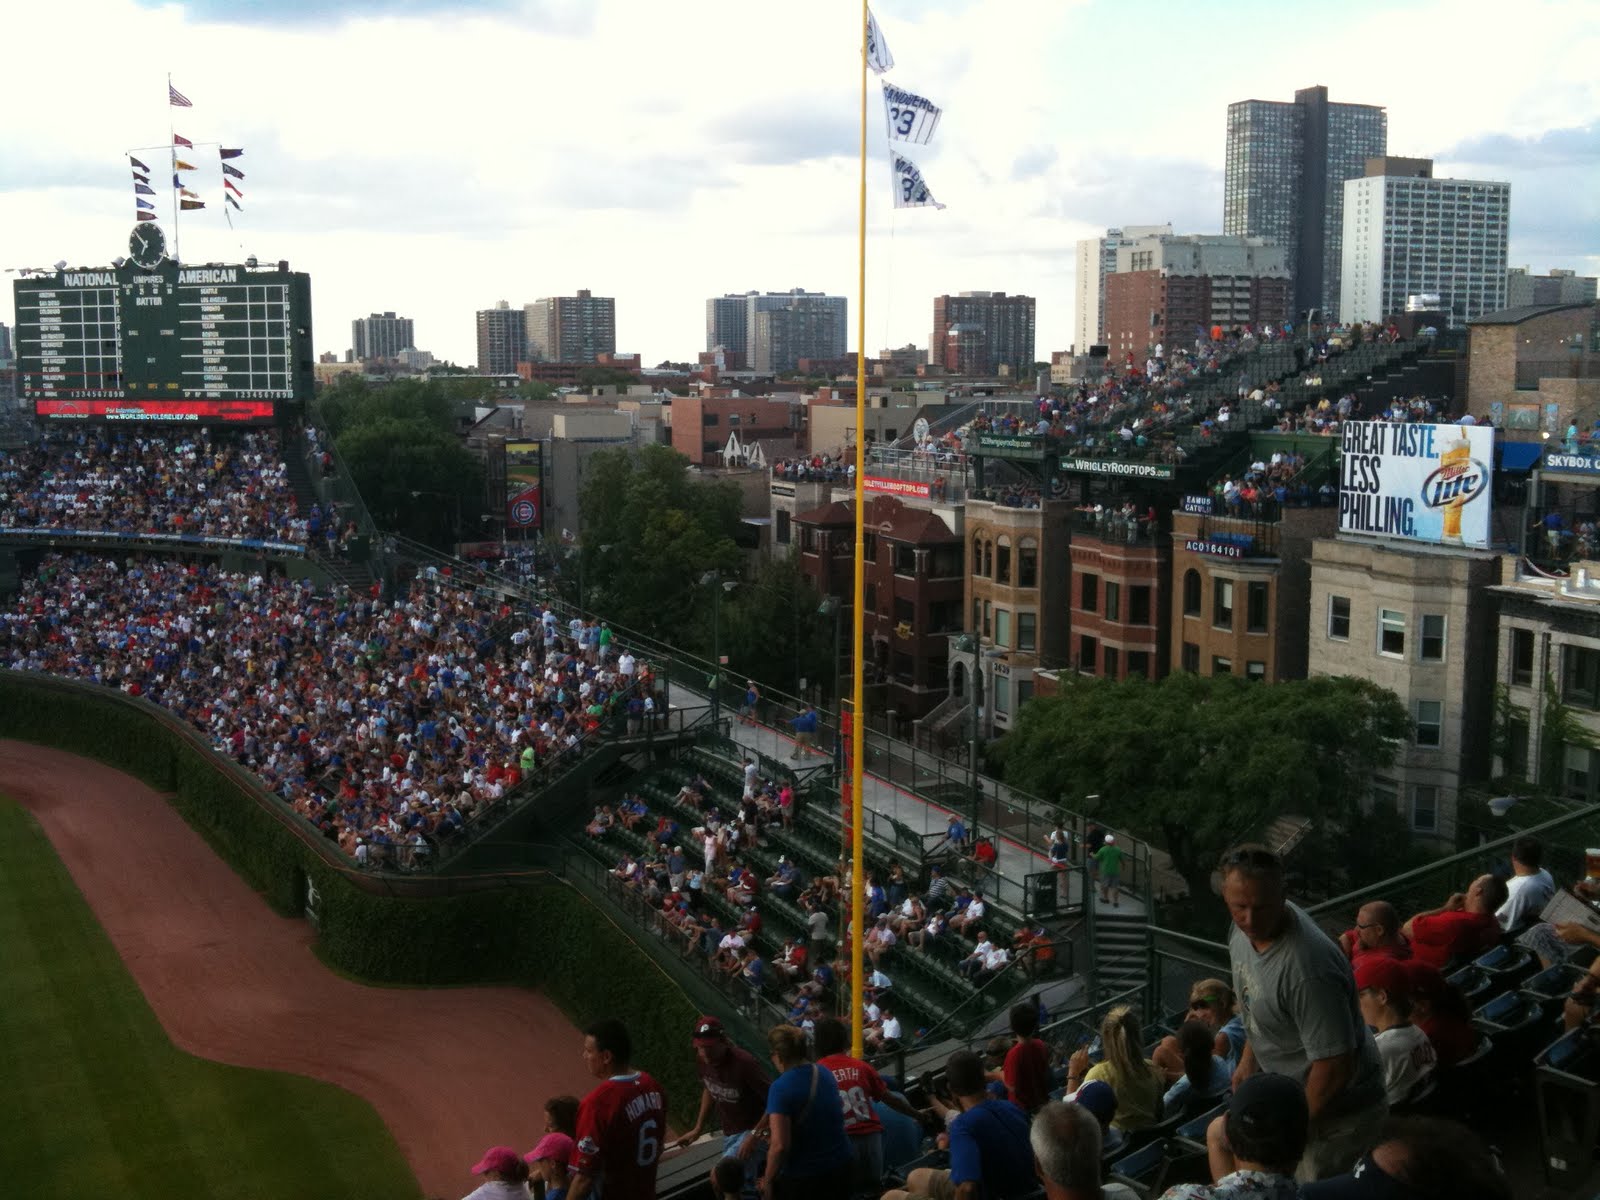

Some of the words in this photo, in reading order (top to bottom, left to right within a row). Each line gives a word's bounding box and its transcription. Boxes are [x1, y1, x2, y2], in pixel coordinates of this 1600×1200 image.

[64, 272, 119, 287] NATIONAL
[133, 275, 164, 284] UMPIRES
[177, 269, 237, 284] AMERICAN
[136, 297, 162, 306] BATTER
[1342, 421, 1387, 455] GREAT
[1391, 422, 1439, 459] TASTE.
[1547, 454, 1592, 469] SKYBOX
[1340, 454, 1381, 494] LESS
[1440, 465, 1470, 480] Miller
[1432, 473, 1479, 508] Lite
[1186, 496, 1211, 505] EAMUS
[1339, 492, 1418, 537] PHILLING.
[832, 1068, 859, 1082] ERTH
[625, 1092, 662, 1123] HOWARD
[635, 1117, 658, 1168] 6
